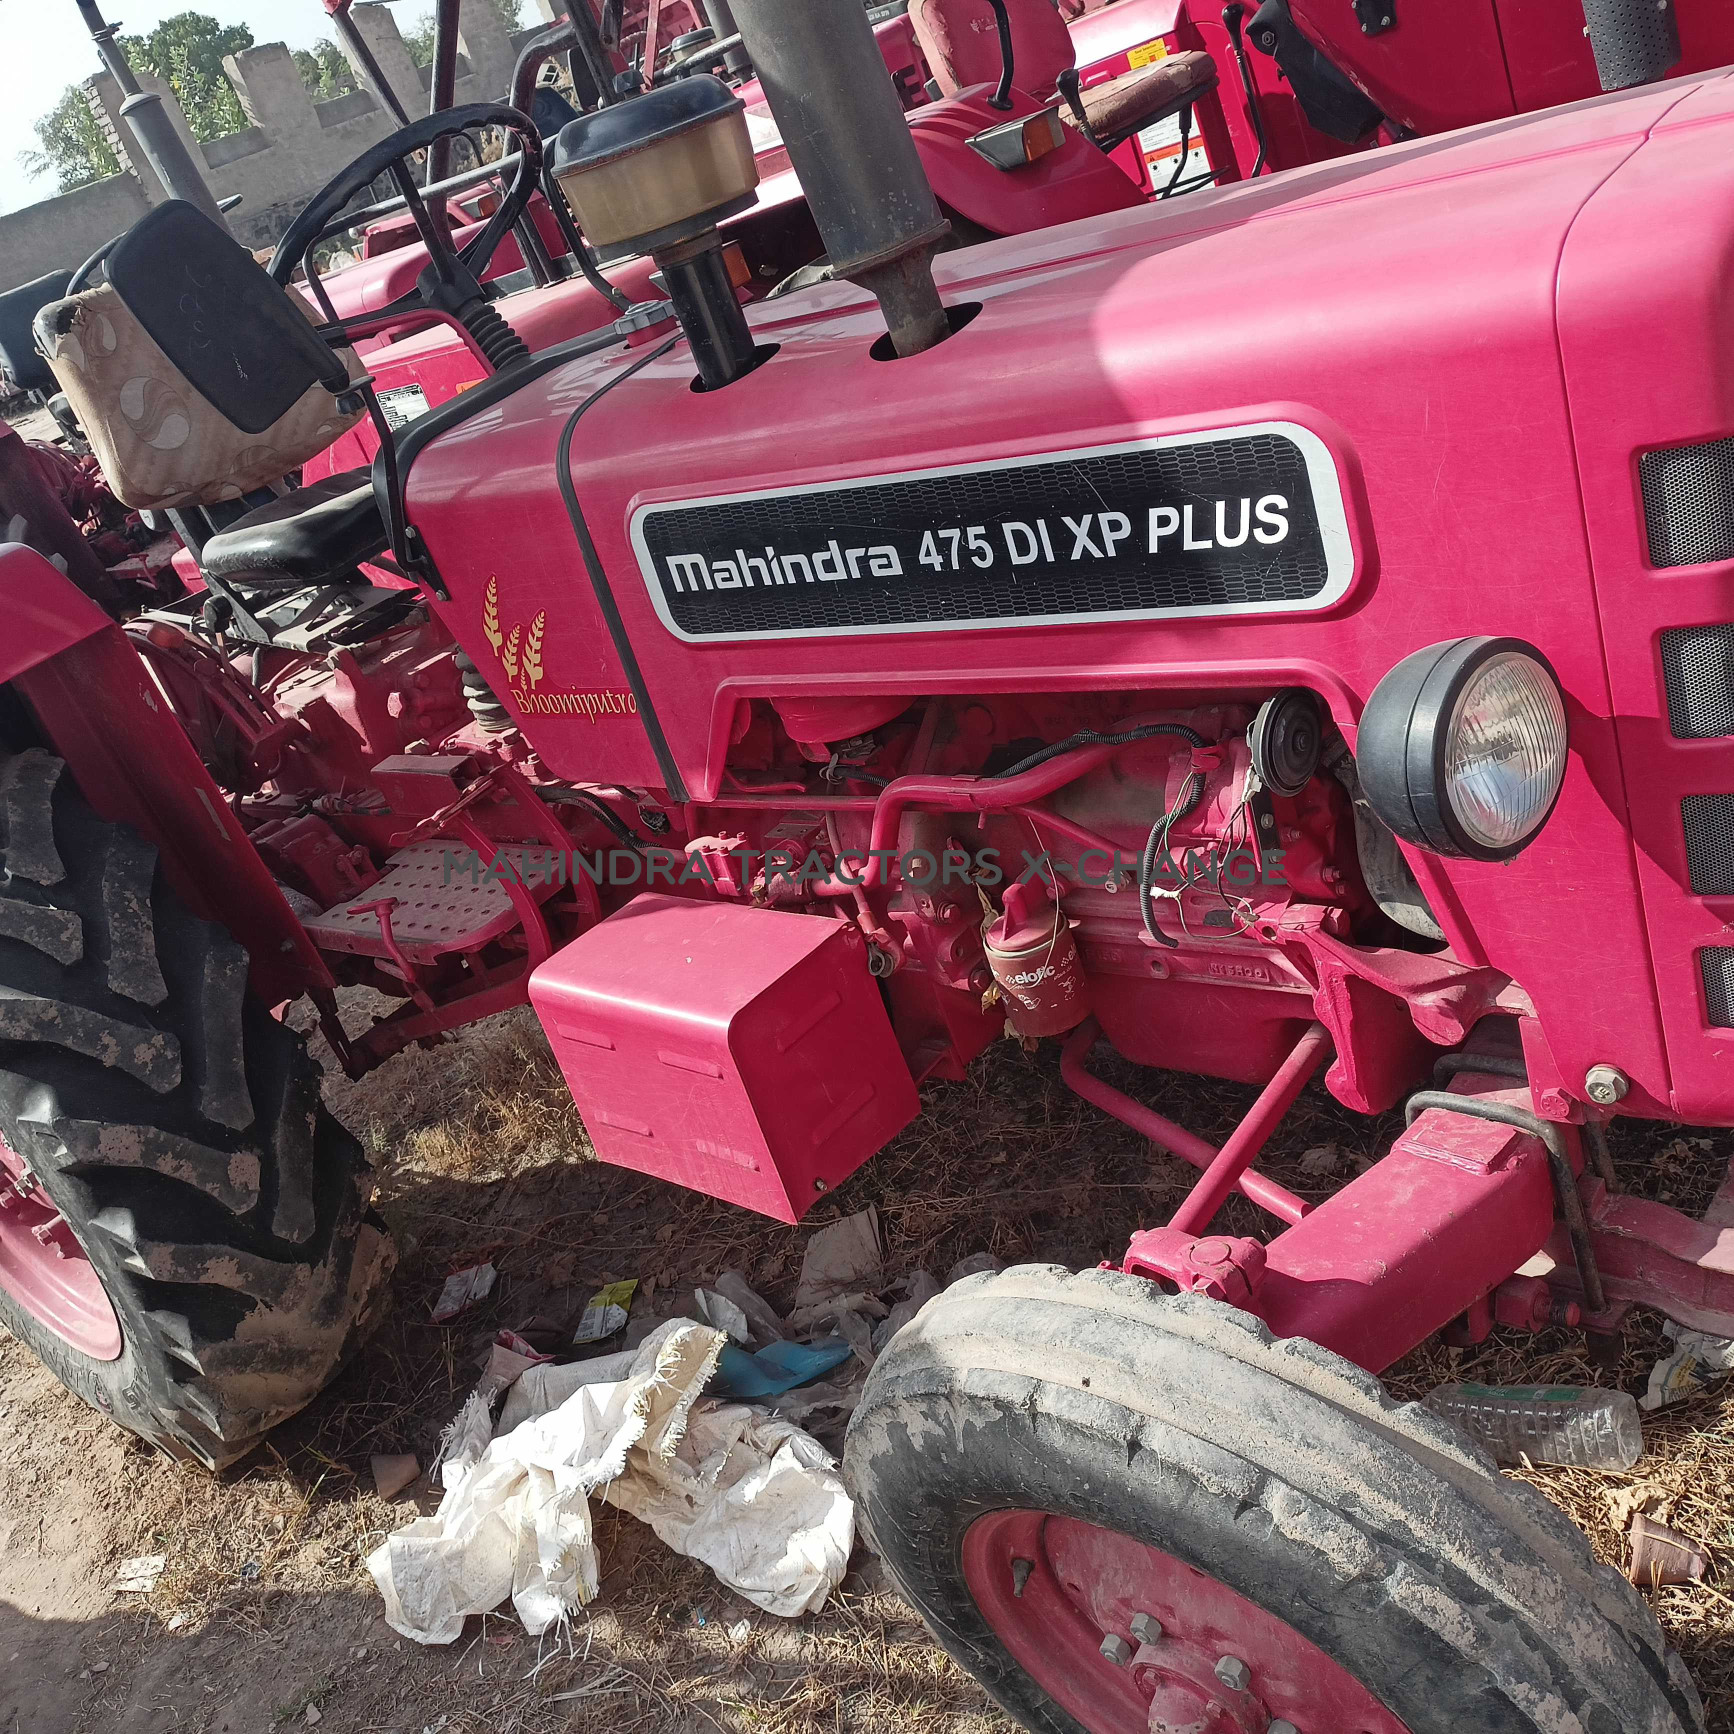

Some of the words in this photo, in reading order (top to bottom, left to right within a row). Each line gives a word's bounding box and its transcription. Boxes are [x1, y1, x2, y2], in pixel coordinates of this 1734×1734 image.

[666, 546, 903, 593] Mahindra
[918, 526, 994, 572] 475
[1002, 519, 1055, 565] DI
[1061, 512, 1132, 561] XP
[1148, 495, 1289, 554] PLUS
